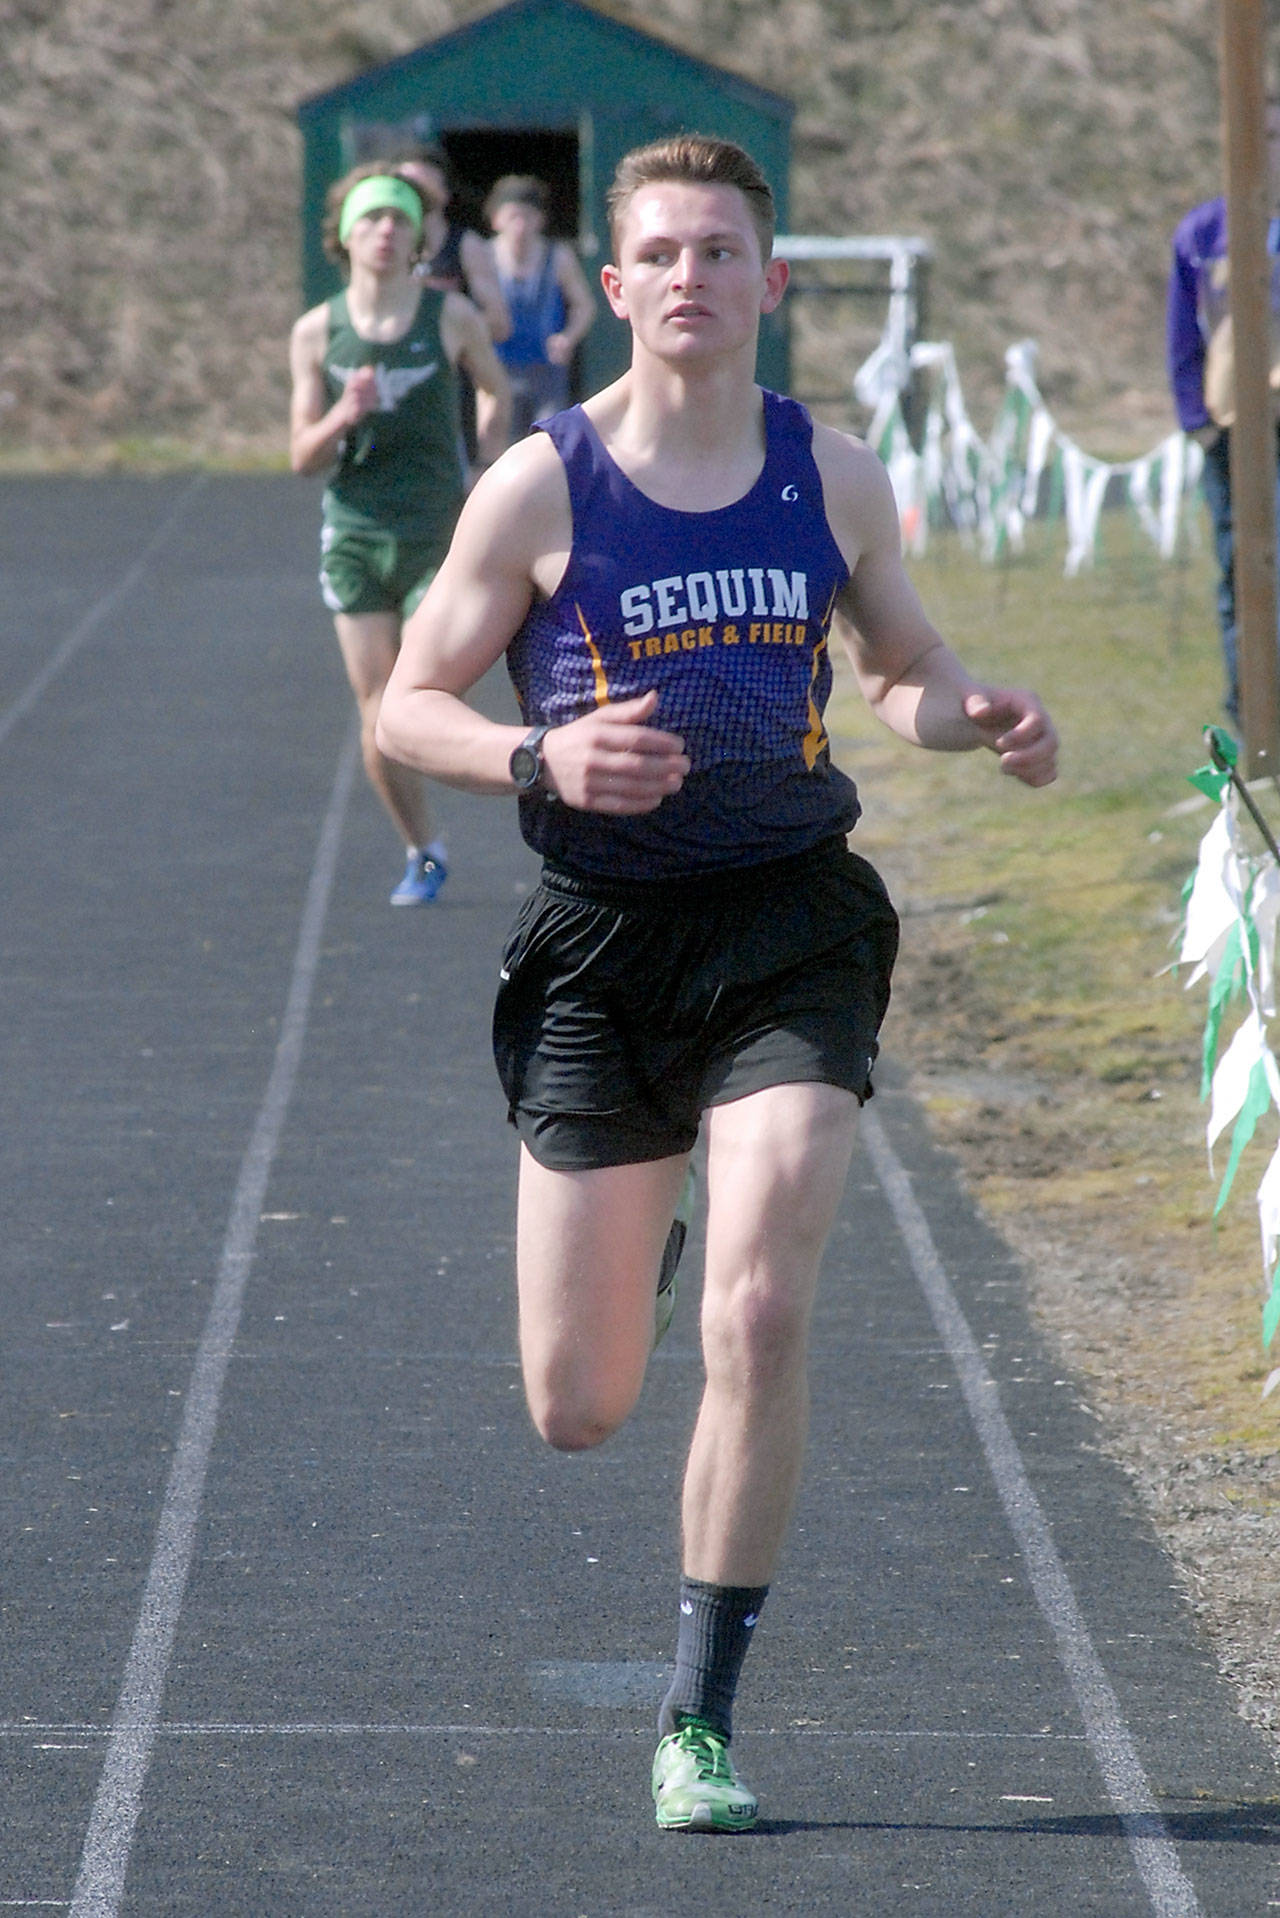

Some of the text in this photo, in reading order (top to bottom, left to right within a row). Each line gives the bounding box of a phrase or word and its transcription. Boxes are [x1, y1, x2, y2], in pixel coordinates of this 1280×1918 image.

[619, 568, 809, 637] SEQUIM
[628, 623, 807, 661] TRACK & FIELD
